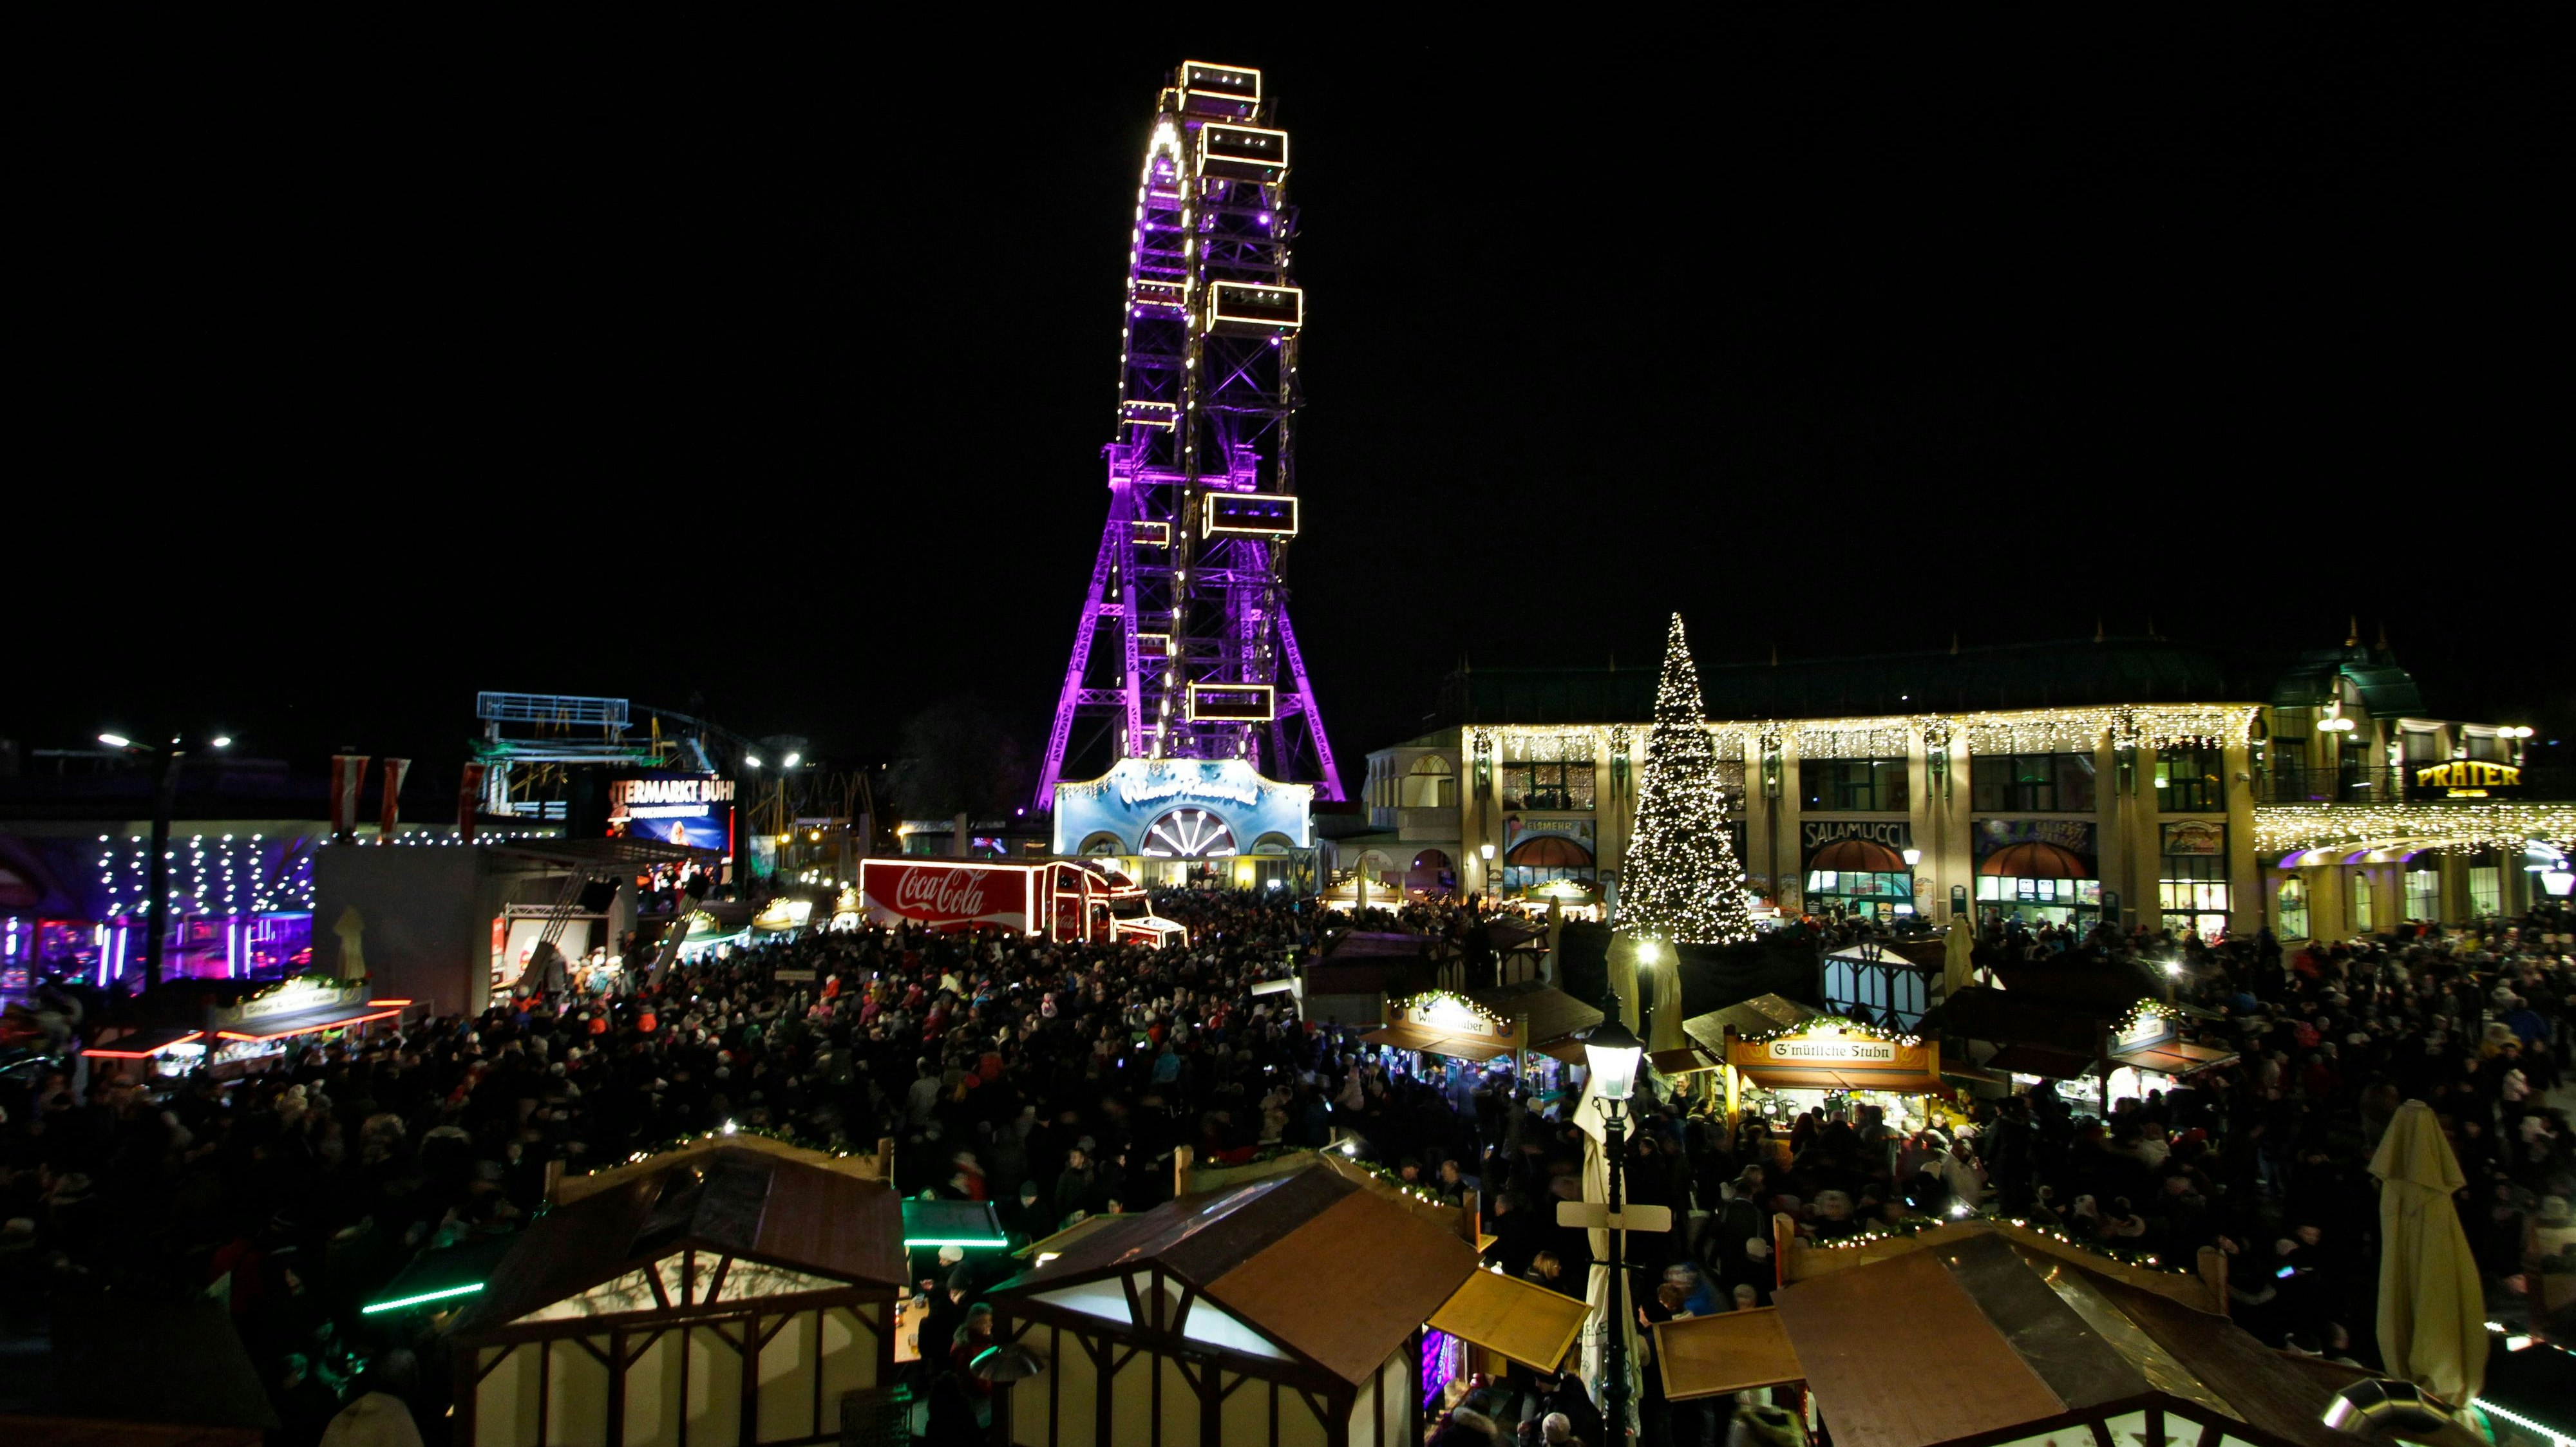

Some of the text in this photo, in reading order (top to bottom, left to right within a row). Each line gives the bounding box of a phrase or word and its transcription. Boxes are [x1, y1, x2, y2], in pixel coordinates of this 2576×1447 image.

[2416, 761, 2522, 786] PRATER
[1804, 823, 1904, 849] SALAMUCCI
[896, 866, 990, 915] Coca-Cola
